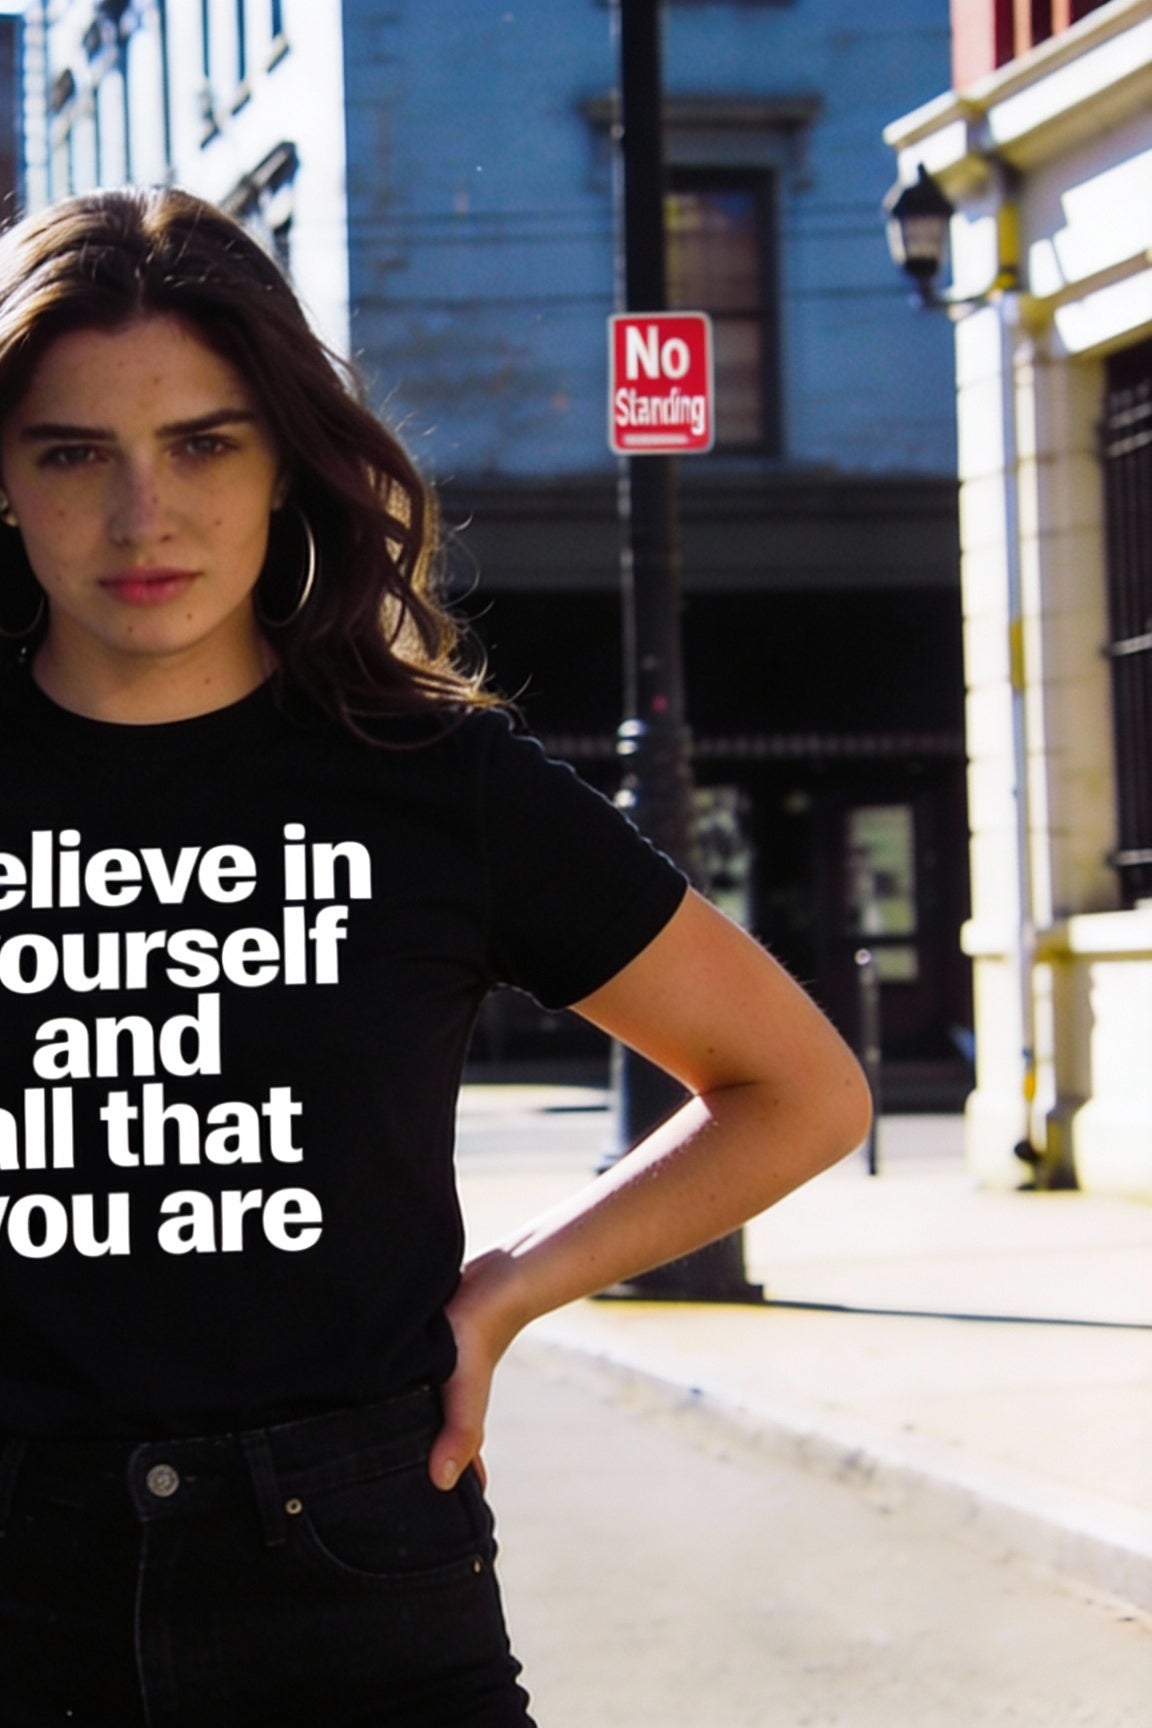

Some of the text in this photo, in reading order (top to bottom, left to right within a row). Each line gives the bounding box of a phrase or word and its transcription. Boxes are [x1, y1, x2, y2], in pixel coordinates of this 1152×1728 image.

[626, 325, 690, 380] No
[283, 822, 372, 901] in
[32, 992, 222, 1080] and
[99, 1082, 304, 1167] that
[157, 1187, 323, 1255] are
